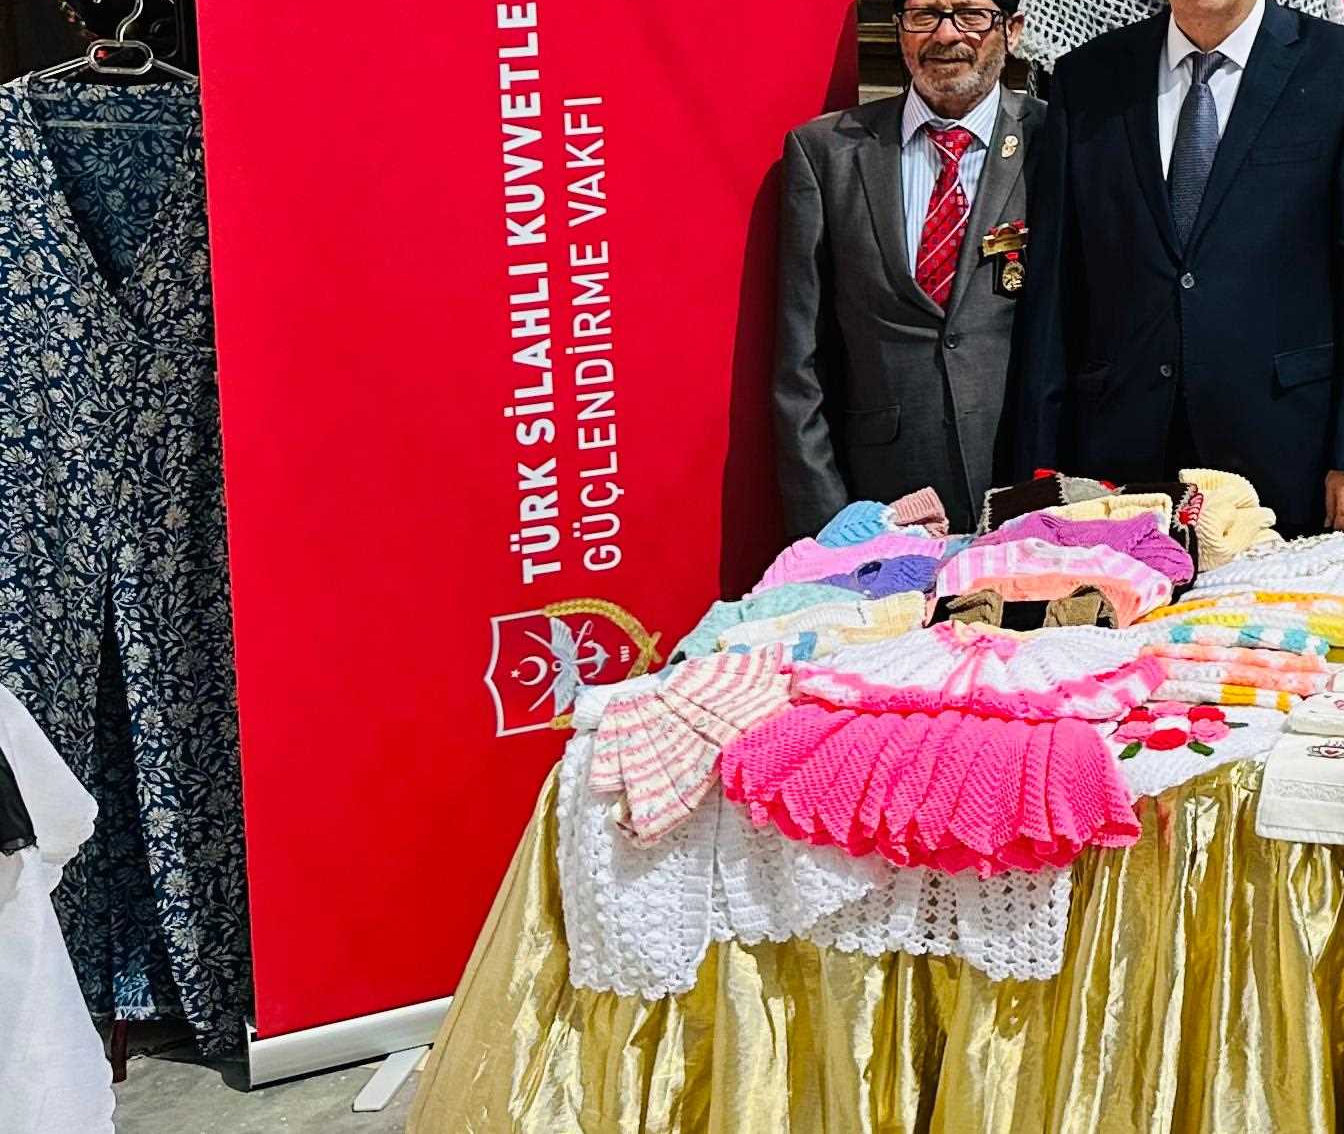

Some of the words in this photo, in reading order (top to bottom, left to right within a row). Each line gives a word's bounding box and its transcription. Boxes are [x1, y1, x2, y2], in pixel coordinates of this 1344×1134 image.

[564, 97, 606, 226] VAKFI
[504, 263, 555, 445] SİLAHLI
[566, 241, 624, 570] GÜÇLENDİRME
[510, 458, 561, 584] TÜRK
